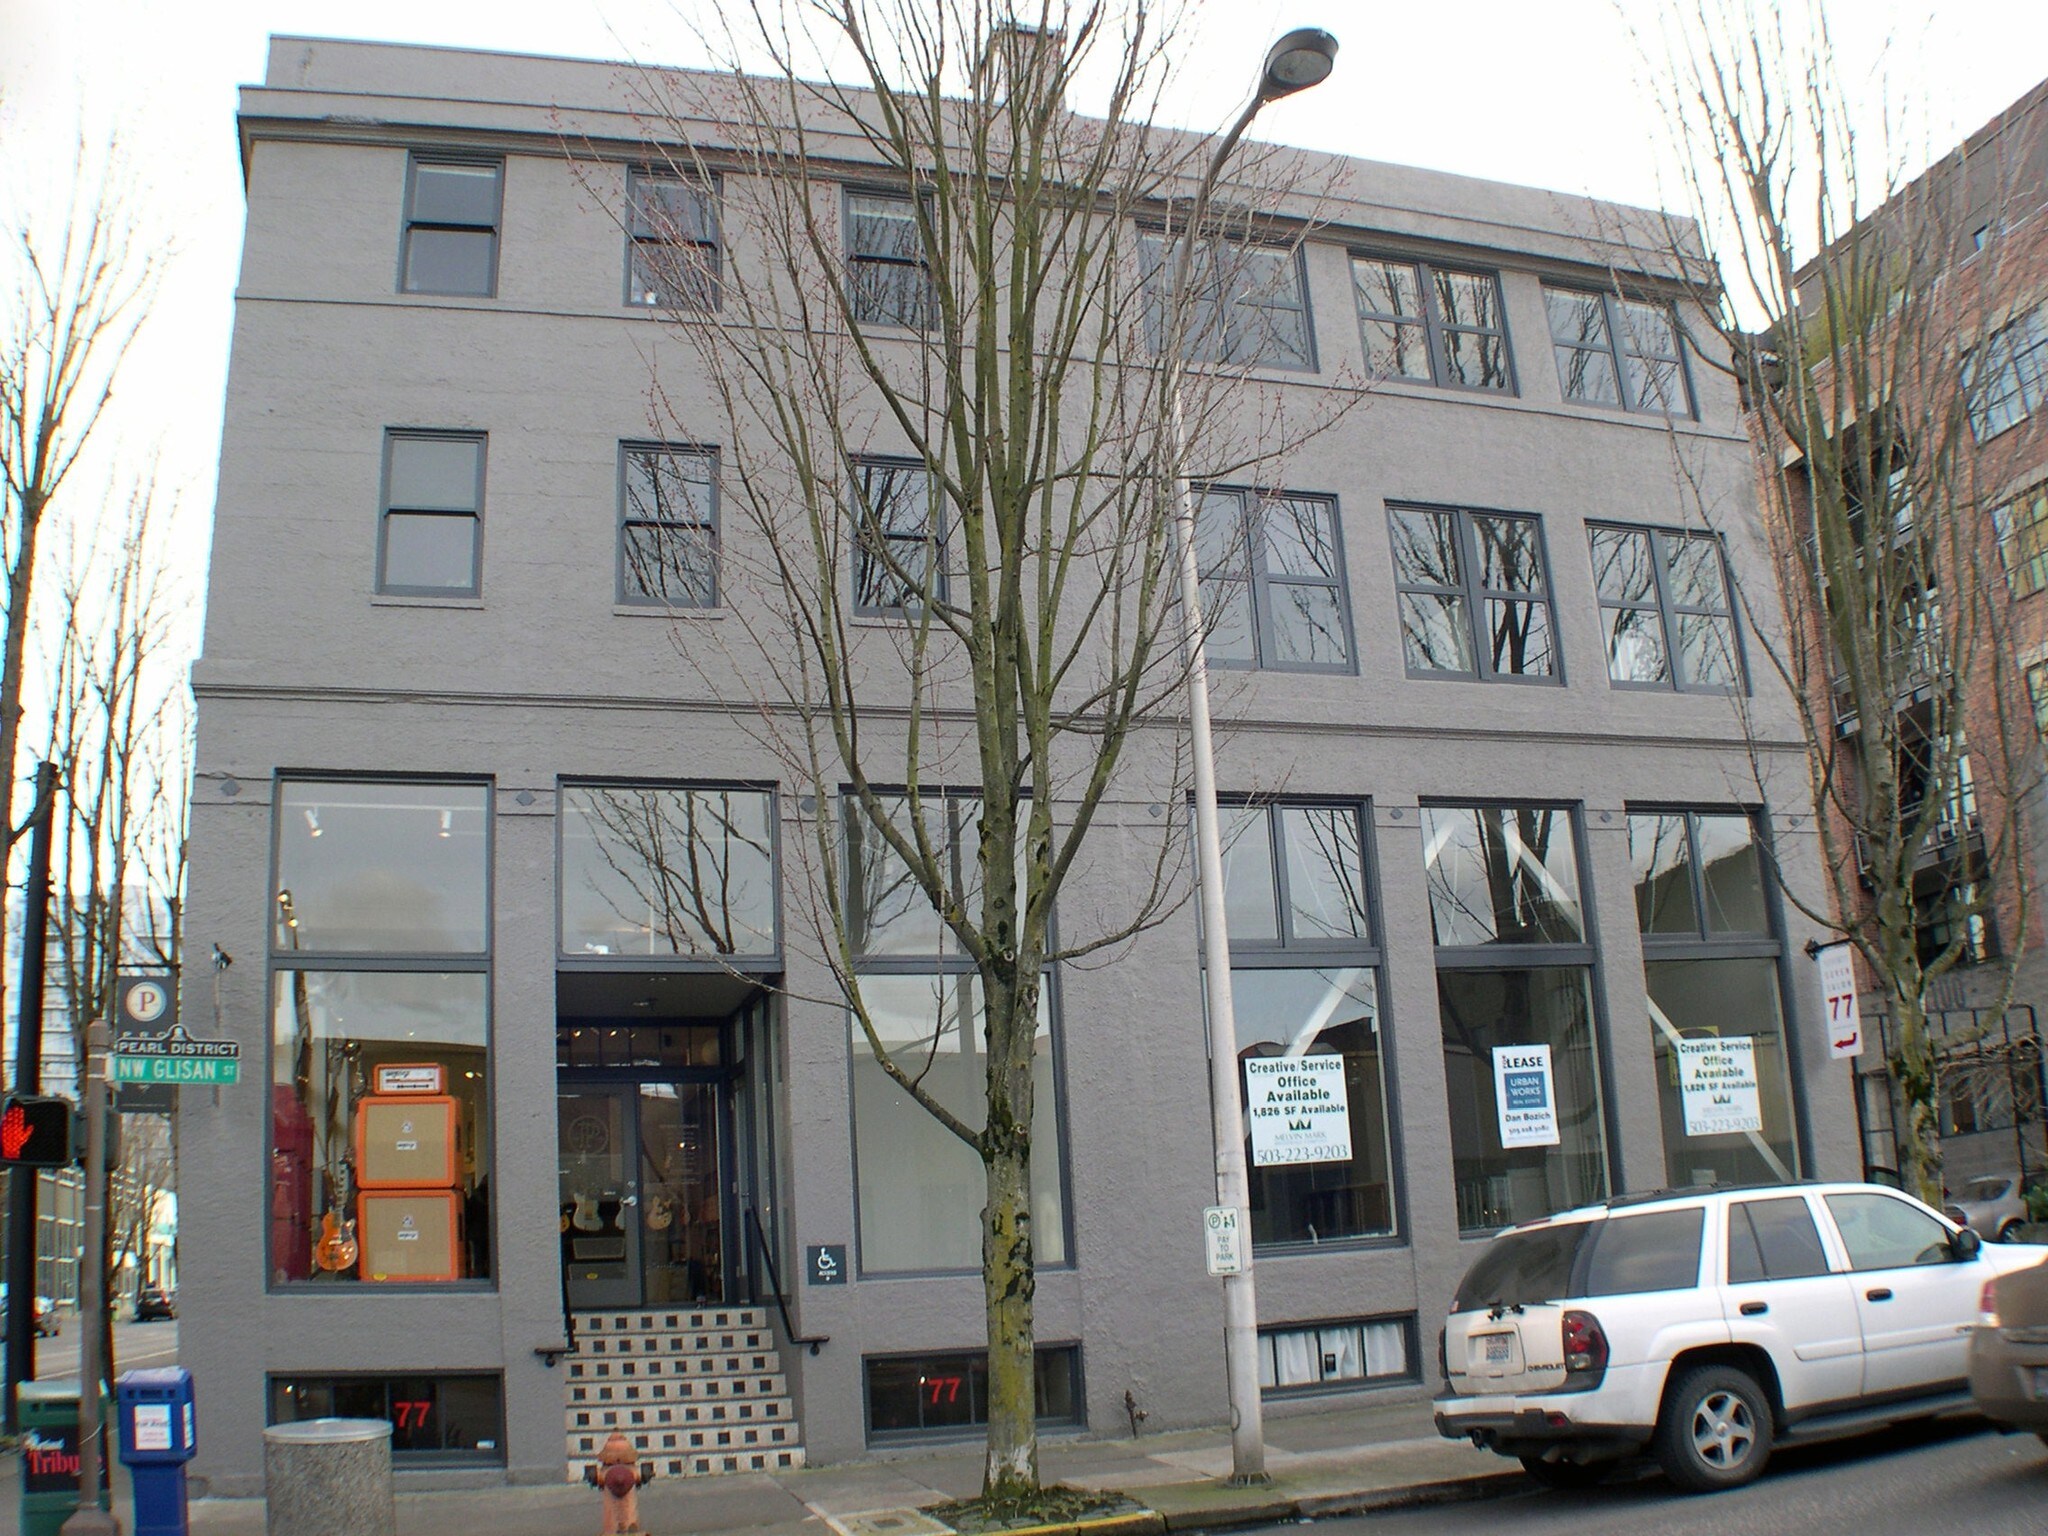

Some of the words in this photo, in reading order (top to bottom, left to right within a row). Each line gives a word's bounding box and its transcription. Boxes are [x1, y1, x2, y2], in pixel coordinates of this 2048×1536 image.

[139, 991, 155, 1012] P
[1828, 994, 1853, 1020] 77
[119, 1042, 167, 1053] PEARL
[171, 1043, 238, 1055] DISTRICT
[1720, 1042, 1751, 1052] Service
[1507, 1056, 1543, 1068] LEASE
[1703, 1056, 1733, 1066] Office
[119, 1059, 147, 1078] NW
[153, 1060, 216, 1080] GLISAN
[223, 1065, 235, 1076] ST
[1695, 1067, 1744, 1079] Available
[1278, 1076, 1317, 1088] Office
[1510, 1076, 1540, 1087] URBAN
[1267, 1089, 1330, 1102] Available
[1511, 1087, 1541, 1097] WORKS
[1253, 1107, 1280, 1118] 1,826
[1284, 1106, 1296, 1115] SF
[1301, 1103, 1345, 1114] Available
[1257, 1144, 1348, 1164] 503-223-9203
[929, 1377, 961, 1404] 77
[394, 1402, 430, 1429] 77
[28, 1450, 103, 1475] Tribu
